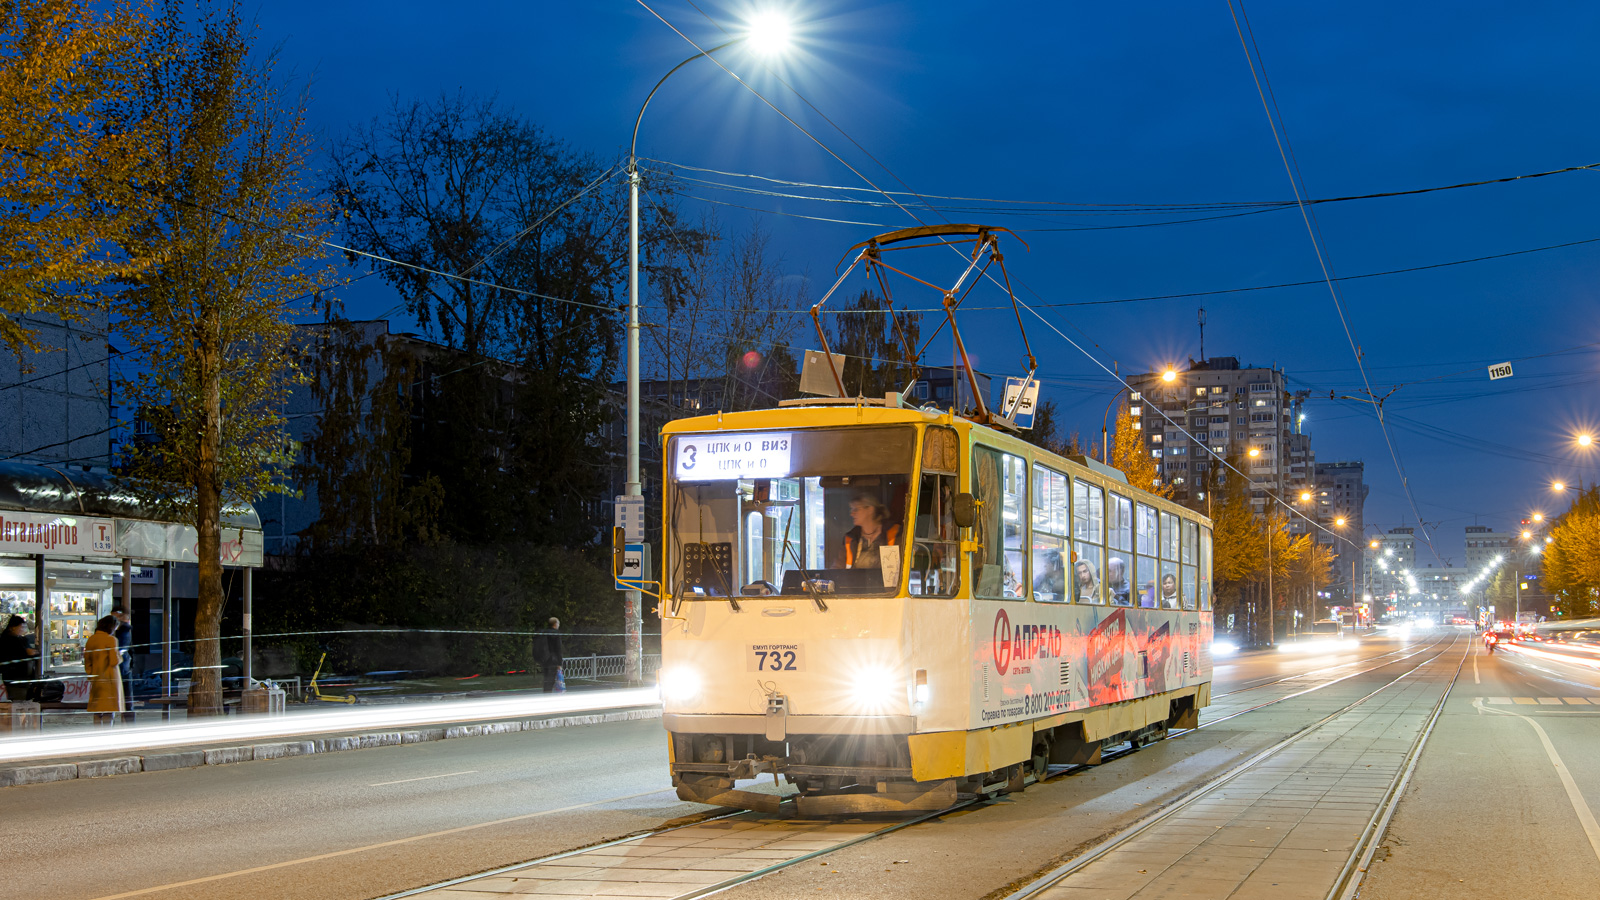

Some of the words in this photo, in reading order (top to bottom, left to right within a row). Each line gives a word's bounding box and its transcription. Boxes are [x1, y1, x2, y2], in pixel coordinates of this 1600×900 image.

[1490, 365, 1512, 378] 1150
[707, 442, 730, 454] ЦПК
[733, 443, 741, 452] и
[761, 439, 788, 452] ВИЗ
[682, 444, 698, 470] 3
[718, 458, 741, 470] ЦПК
[1012, 624, 1062, 661] АПРЕЛЬ
[755, 651, 797, 671] 732
[1024, 694, 1030, 715] 8
[1030, 692, 1043, 714] 800
[982, 708, 1001, 723] Справка
[1001, 709, 1007, 718] по
